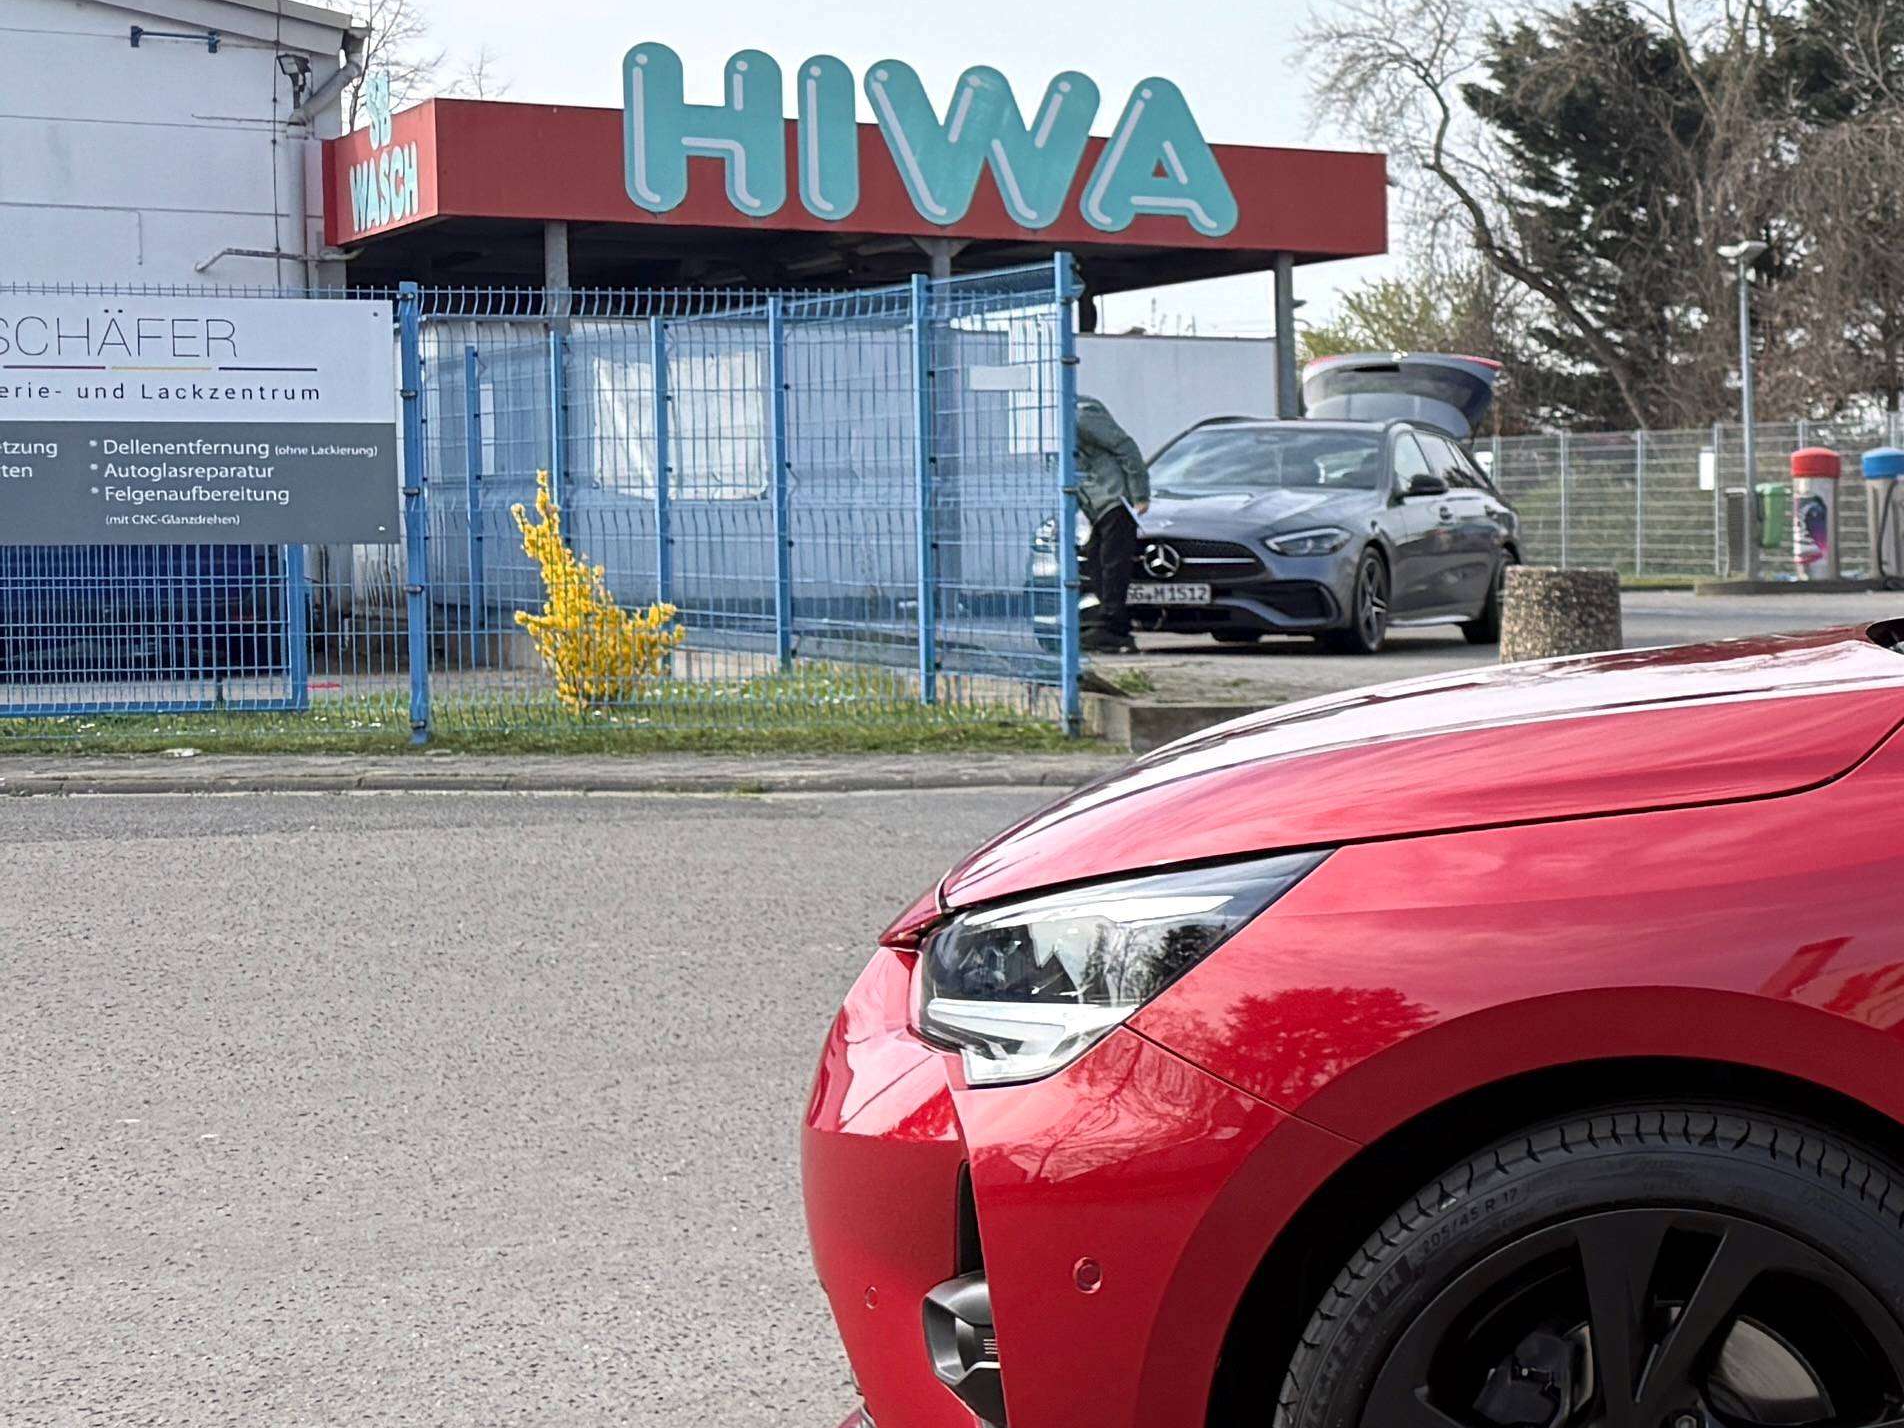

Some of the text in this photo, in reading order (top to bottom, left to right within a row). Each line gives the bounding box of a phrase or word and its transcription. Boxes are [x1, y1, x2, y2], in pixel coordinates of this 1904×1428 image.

[623, 41, 1238, 237] HIWA
[350, 140, 419, 234] WASCH
[77, 382, 124, 399] und
[141, 383, 321, 400] Lackzentrum
[0, 441, 58, 459] tzung
[103, 439, 378, 459] Dellenentfernung (ohne Lackierung)
[104, 462, 274, 482] Autoglasreparatur
[105, 485, 290, 505] Felgenaufbereitung
[105, 514, 240, 526] (mit CNC-Glanzdrehen)
